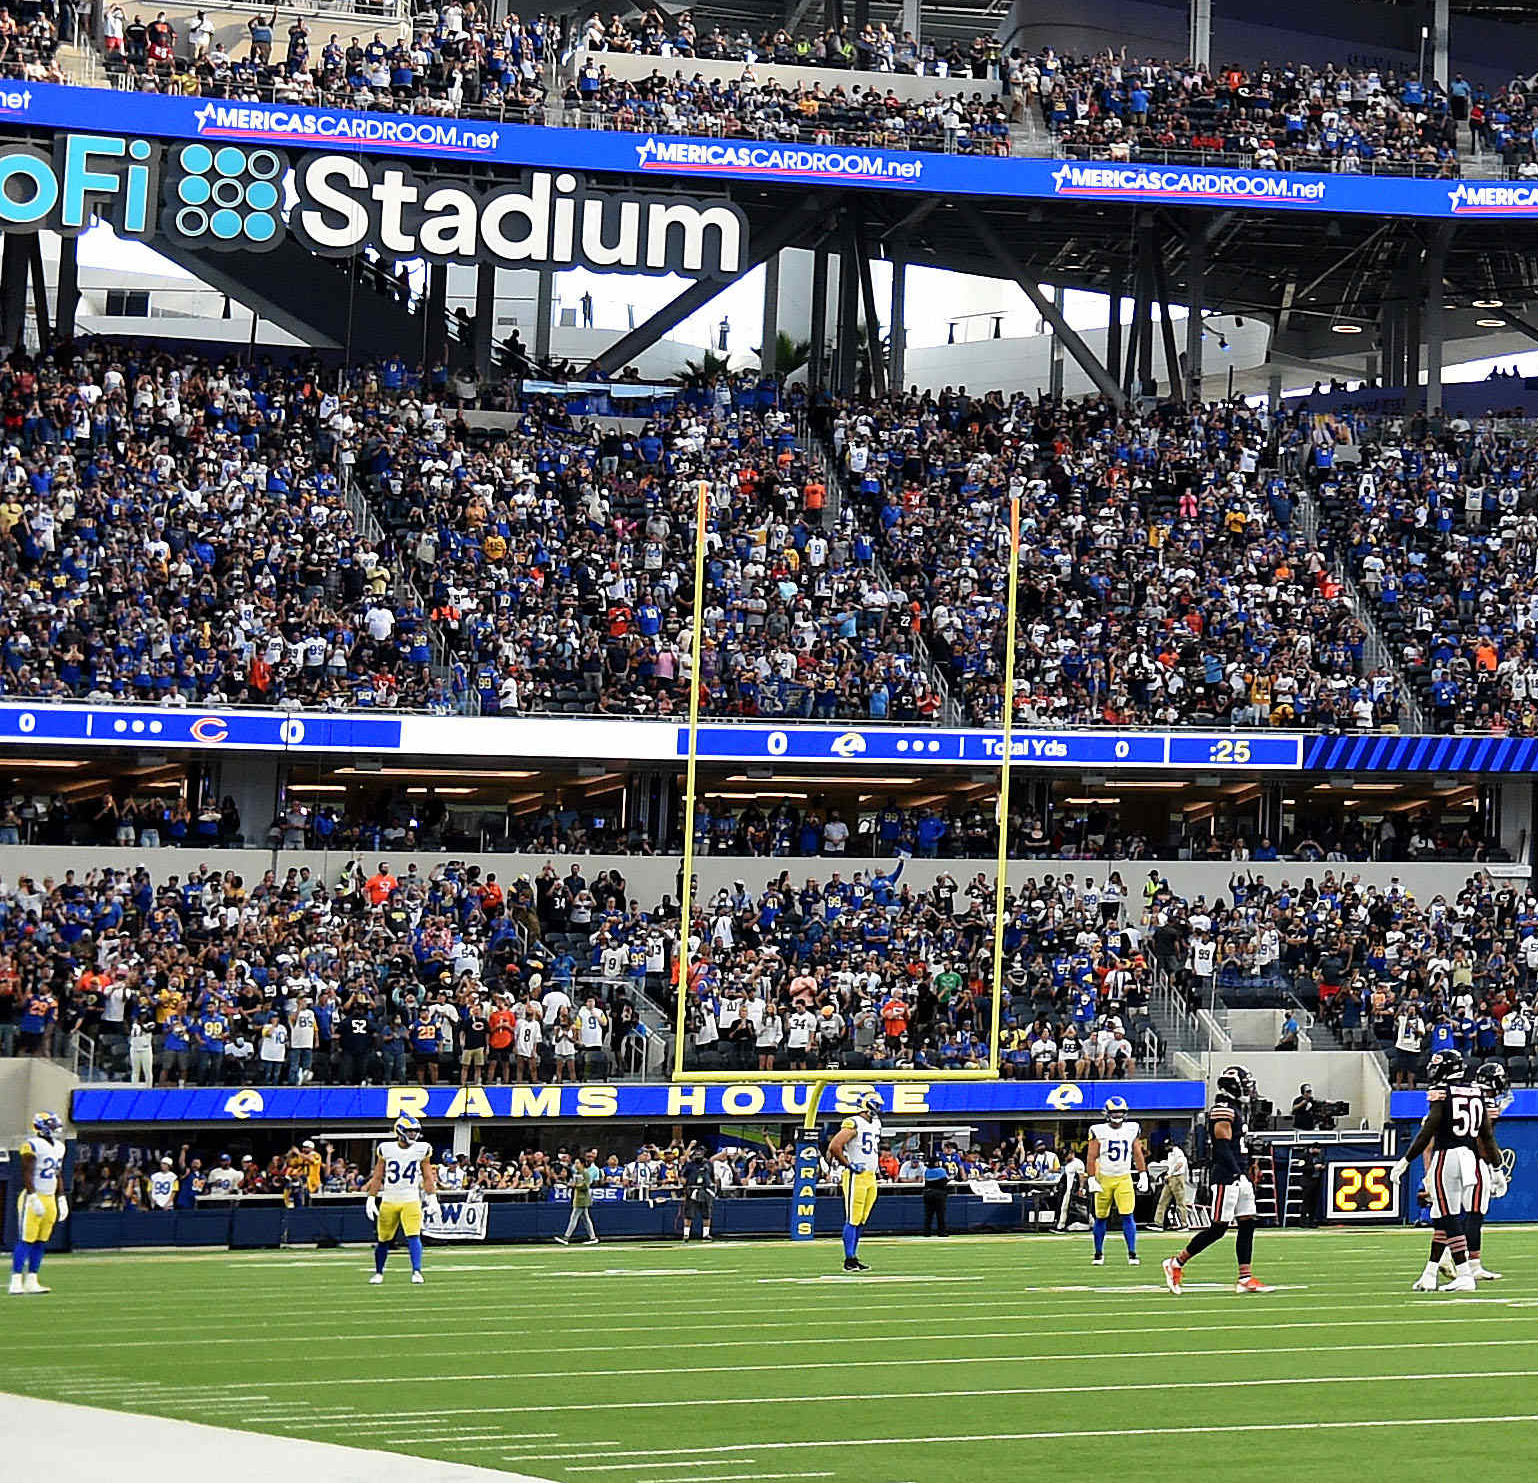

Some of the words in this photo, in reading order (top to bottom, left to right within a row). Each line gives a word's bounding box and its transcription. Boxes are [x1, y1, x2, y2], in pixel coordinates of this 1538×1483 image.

[302, 153, 742, 274] Stadium
[18, 714, 36, 733] 0
[279, 720, 305, 744] 0
[767, 730, 787, 756] 0
[1031, 738, 1068, 759] Yds
[1115, 740, 1129, 759] 0
[1209, 739, 1251, 764] :25
[554, 898, 565, 909] 34
[766, 898, 778, 908] 41
[609, 957, 616, 969] 9
[204, 1021, 222, 1037] 99
[351, 1019, 367, 1034] 52
[588, 1017, 596, 1029] 9
[1439, 1028, 1447, 1039] 9
[524, 1029, 531, 1041] 8
[387, 1086, 618, 1119] RAMS
[668, 1083, 931, 1117] HOUSE
[1452, 1097, 1483, 1138] 50
[1107, 1140, 1130, 1163] 51
[386, 1160, 416, 1185] 34
[1337, 1167, 1390, 1211] 25
[797, 1167, 816, 1235] RAMS
